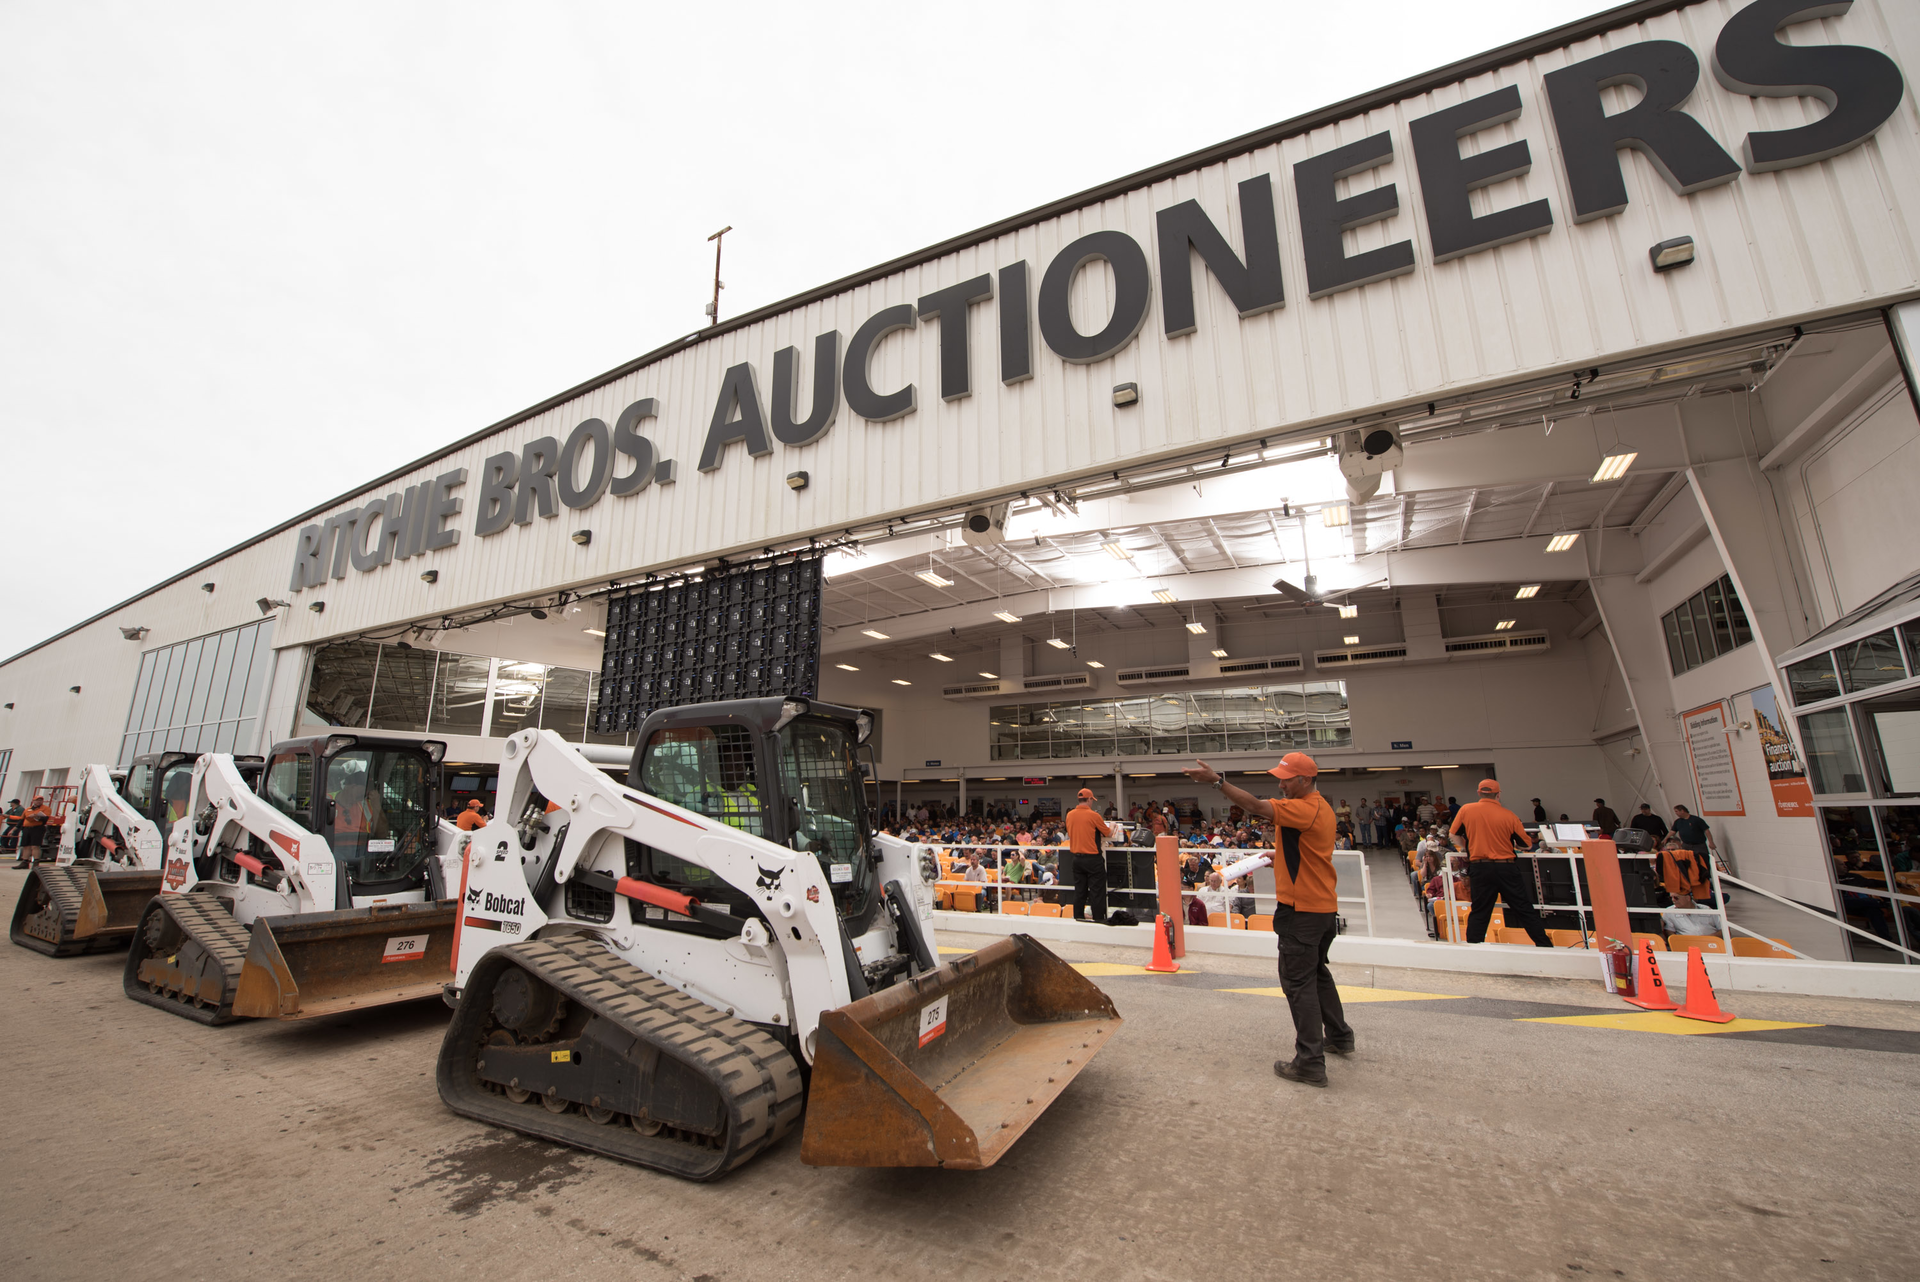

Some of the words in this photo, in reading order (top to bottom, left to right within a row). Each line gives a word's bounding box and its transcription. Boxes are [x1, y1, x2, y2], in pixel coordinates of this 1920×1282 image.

[289, 467, 467, 593] RITCHIE
[475, 397, 678, 537] BROS.
[697, 0, 1904, 474] AUCTIONEERS
[1765, 744, 1789, 756] Finance
[1769, 758, 1792, 773] auction
[484, 892, 526, 916] Bobcat
[502, 920, 522, 935] T650
[396, 940, 416, 951] 276
[1645, 944, 1662, 988] SOLD
[927, 1006, 940, 1026] 275
